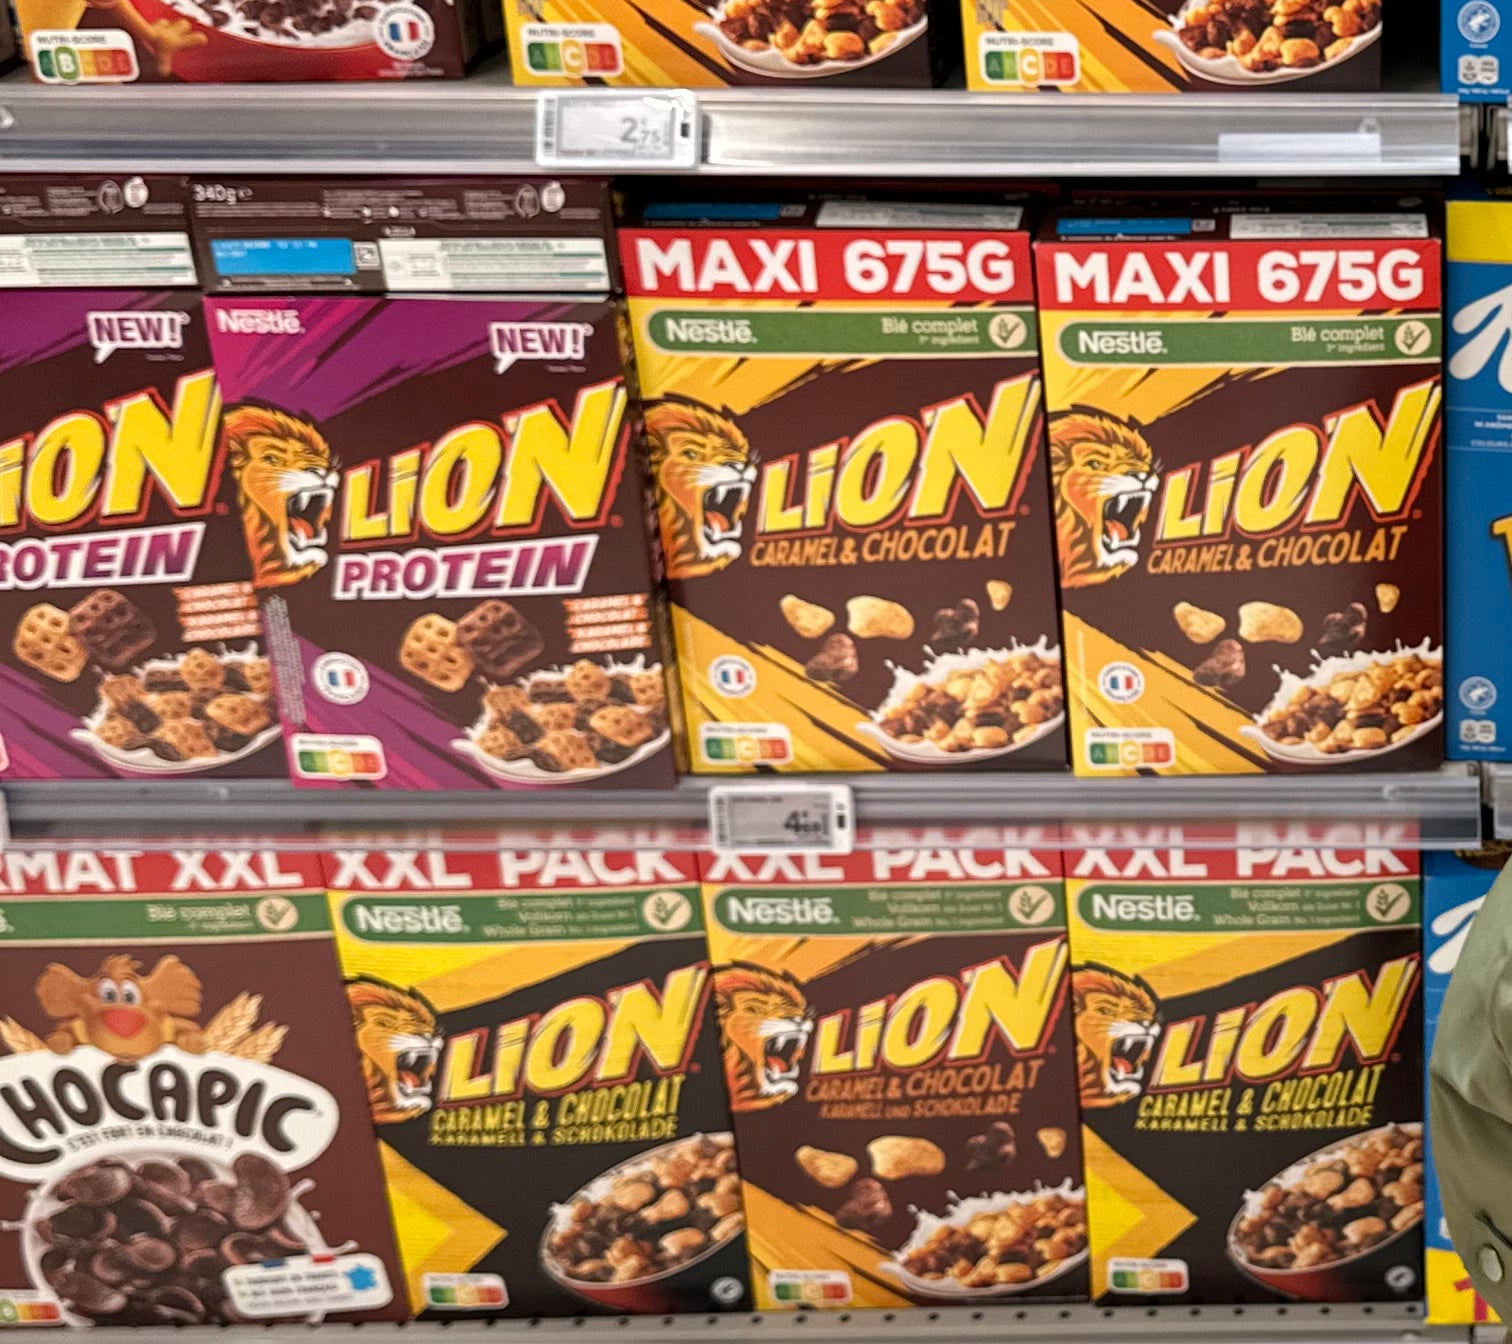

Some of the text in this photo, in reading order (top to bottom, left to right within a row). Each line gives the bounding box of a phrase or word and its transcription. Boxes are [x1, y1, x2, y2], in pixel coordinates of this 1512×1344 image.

[636, 237, 1015, 295] MAXI 675G
[1054, 248, 1424, 304] MAXI 675G
[912, 318, 979, 338] complet
[1078, 330, 1168, 356] Nestlé
[1320, 326, 1385, 344] complet
[338, 376, 630, 547] LION
[755, 369, 1044, 537] LION
[1153, 374, 1442, 548] LION
[341, 541, 592, 594] PROTEIN
[751, 521, 1016, 568] CARAMEL CHOCOLAT
[1147, 526, 1408, 575] CARAMEL CHOCOLAT
[1093, 893, 1200, 922] Nestlé
[809, 934, 1072, 1080] LION
[1147, 951, 1421, 1094] LION
[438, 960, 710, 1108] LION
[558, 1073, 686, 1126] CHOCOLAT
[907, 1058, 1045, 1097] CHOCOLAT
[1261, 1064, 1386, 1113] CHOCOLAT
